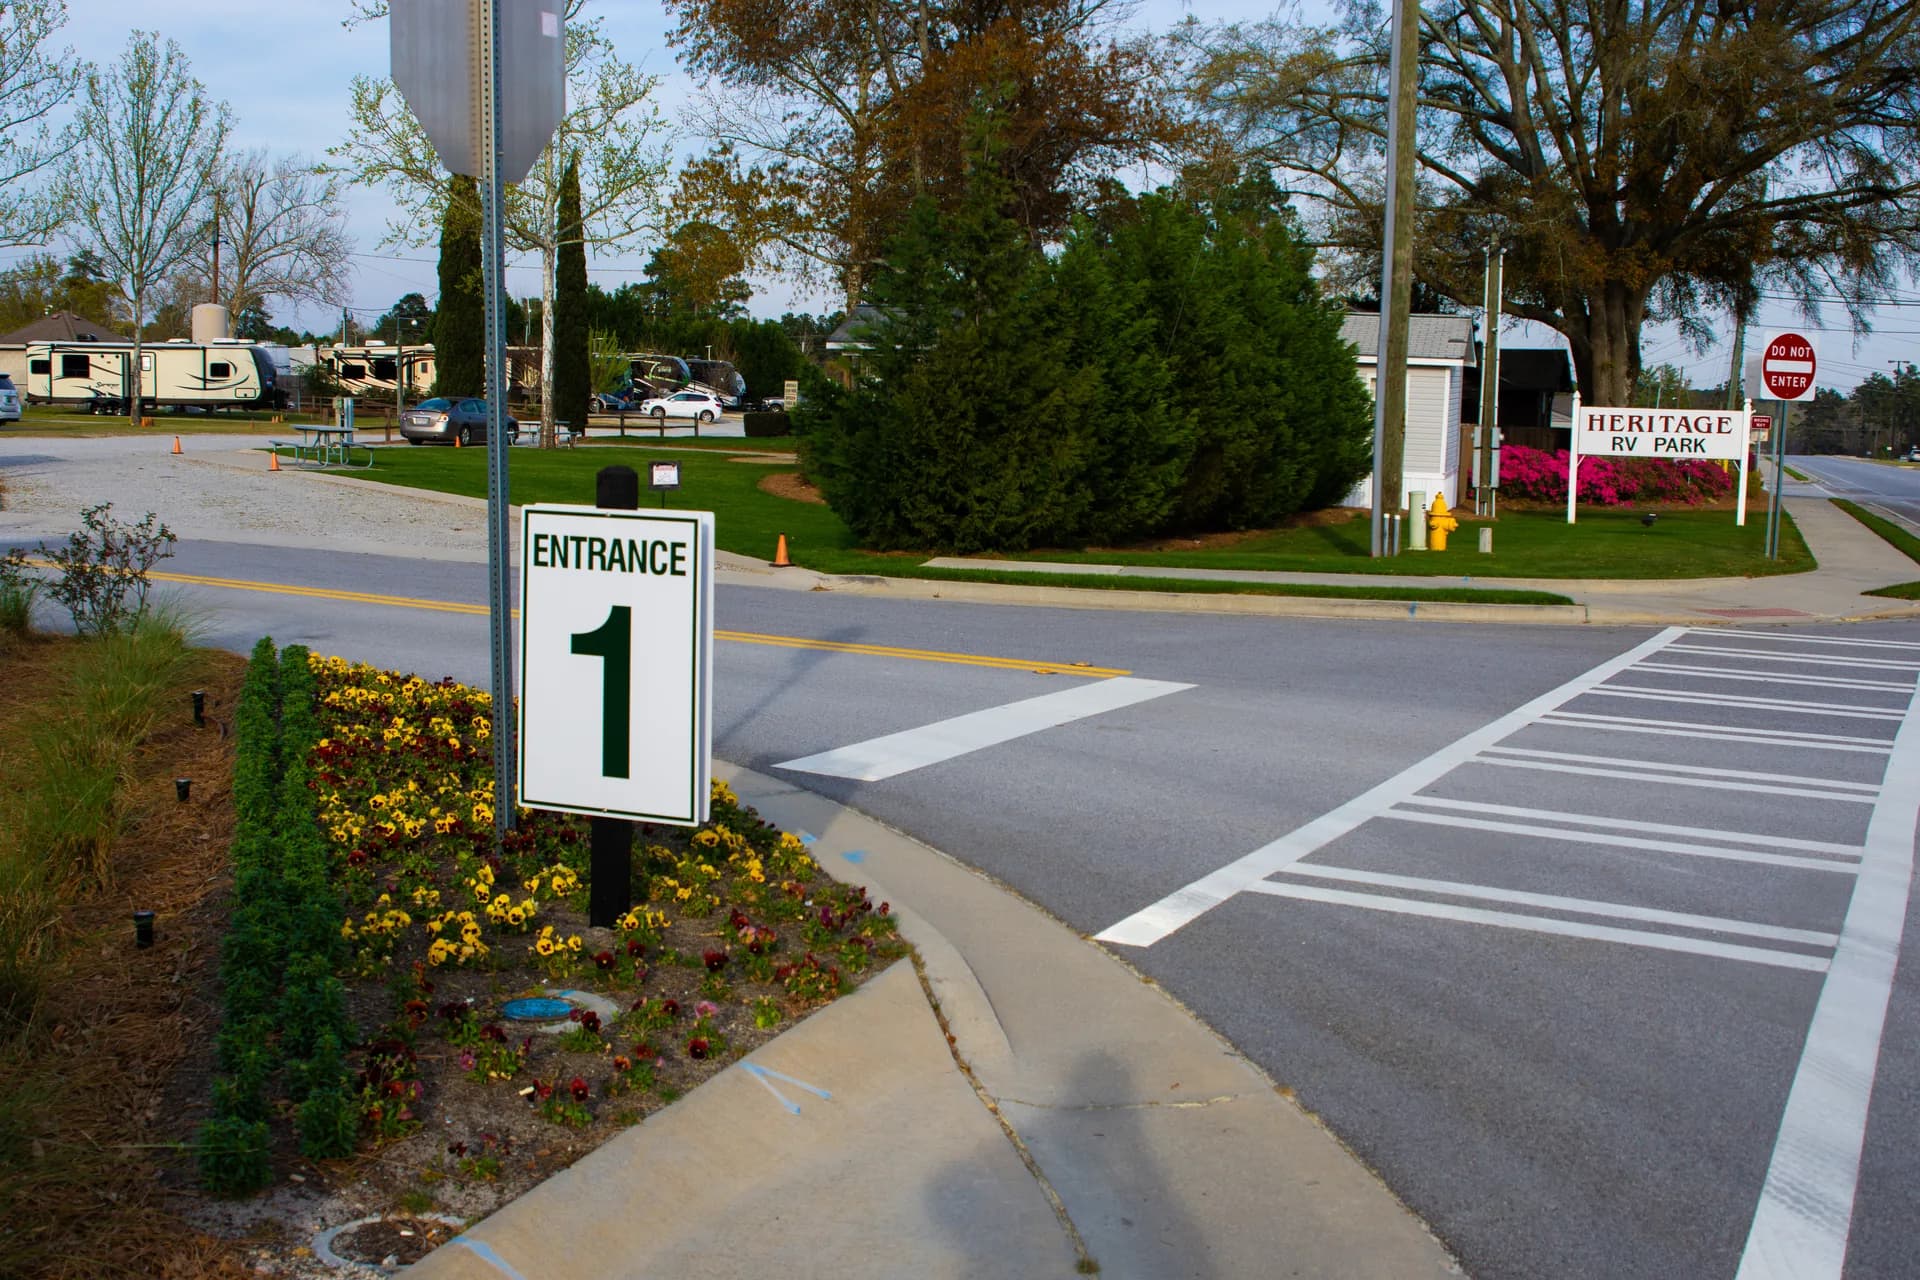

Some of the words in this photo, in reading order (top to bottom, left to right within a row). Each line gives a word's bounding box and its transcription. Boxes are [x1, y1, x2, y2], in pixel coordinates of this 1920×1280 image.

[1771, 345, 1786, 357] DO
[1790, 346, 1812, 358] NOT
[1771, 375, 1807, 388] ENTER
[1588, 414, 1733, 434] HERITAGE
[1611, 436, 1638, 451] RV
[1653, 437, 1706, 453] PARK
[533, 533, 686, 576] ENTRANCE
[571, 605, 631, 779] 1
